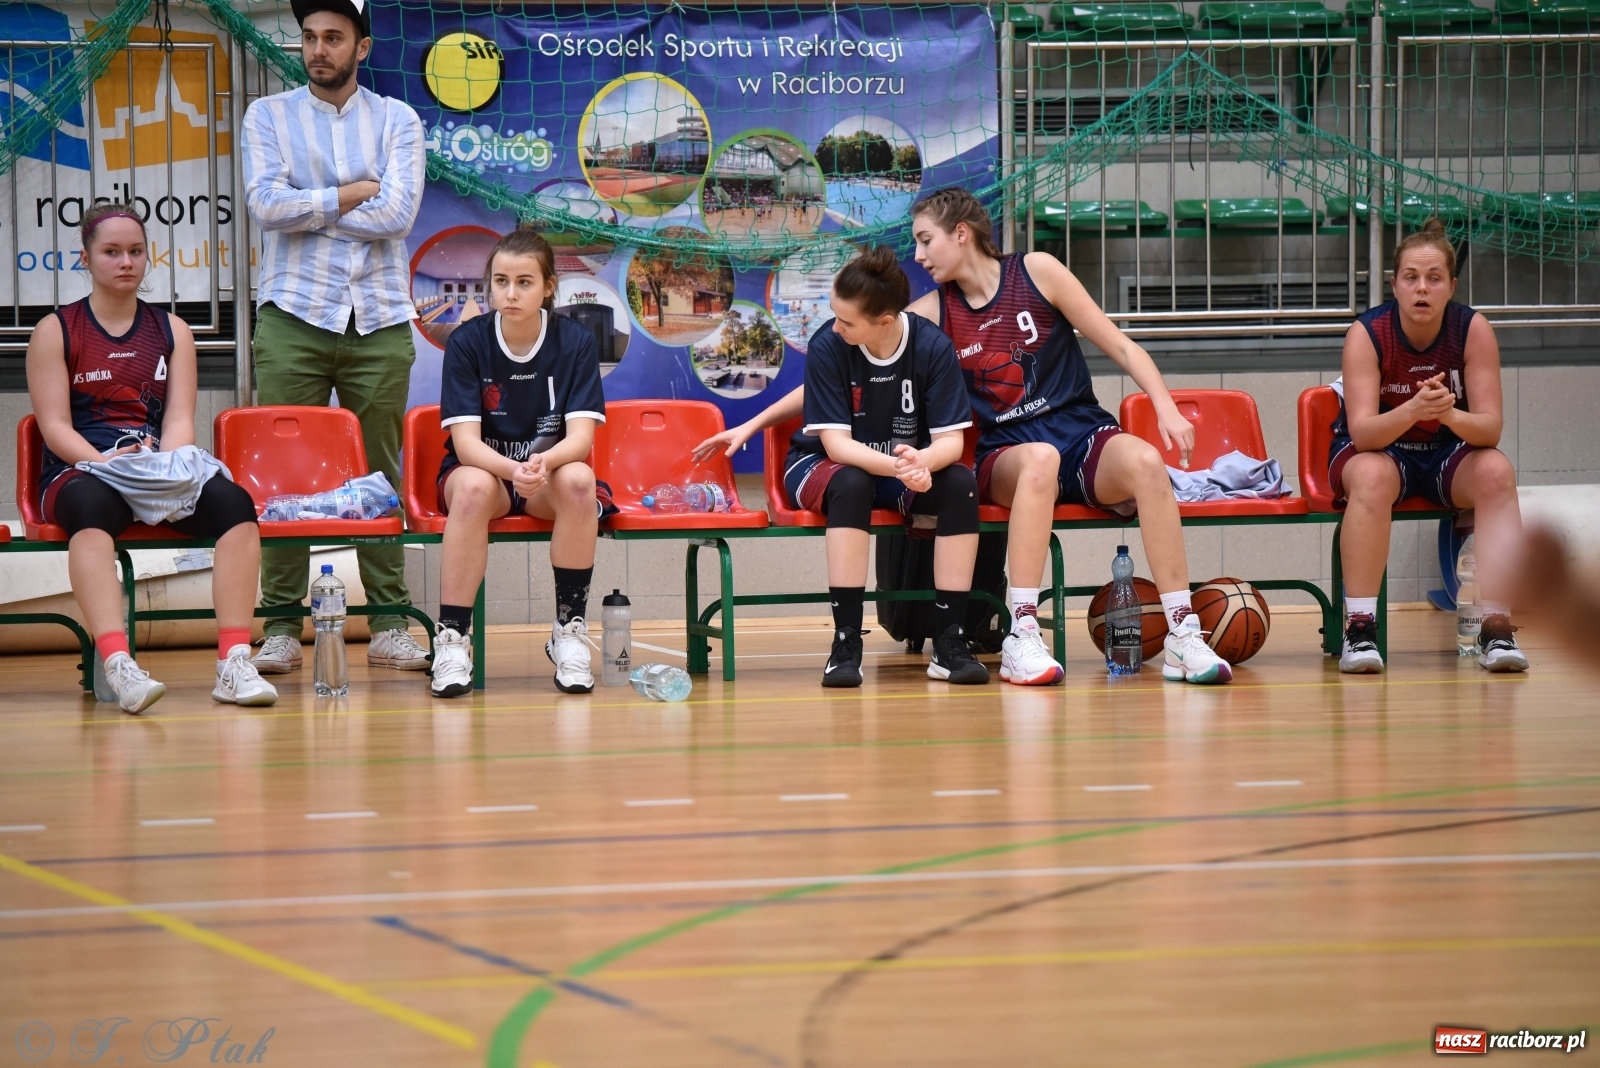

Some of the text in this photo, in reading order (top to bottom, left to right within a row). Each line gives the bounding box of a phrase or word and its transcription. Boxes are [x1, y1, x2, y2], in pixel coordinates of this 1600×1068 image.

[538, 33, 904, 62] Ośrodek Sportu i Rekreacji
[737, 71, 905, 95] w Raciborzu
[1016, 310, 1039, 345] 9
[86, 368, 112, 383] DWÓJKA
[547, 376, 556, 411] 1
[901, 378, 914, 413] 8
[1023, 397, 1047, 414] POLSKA
